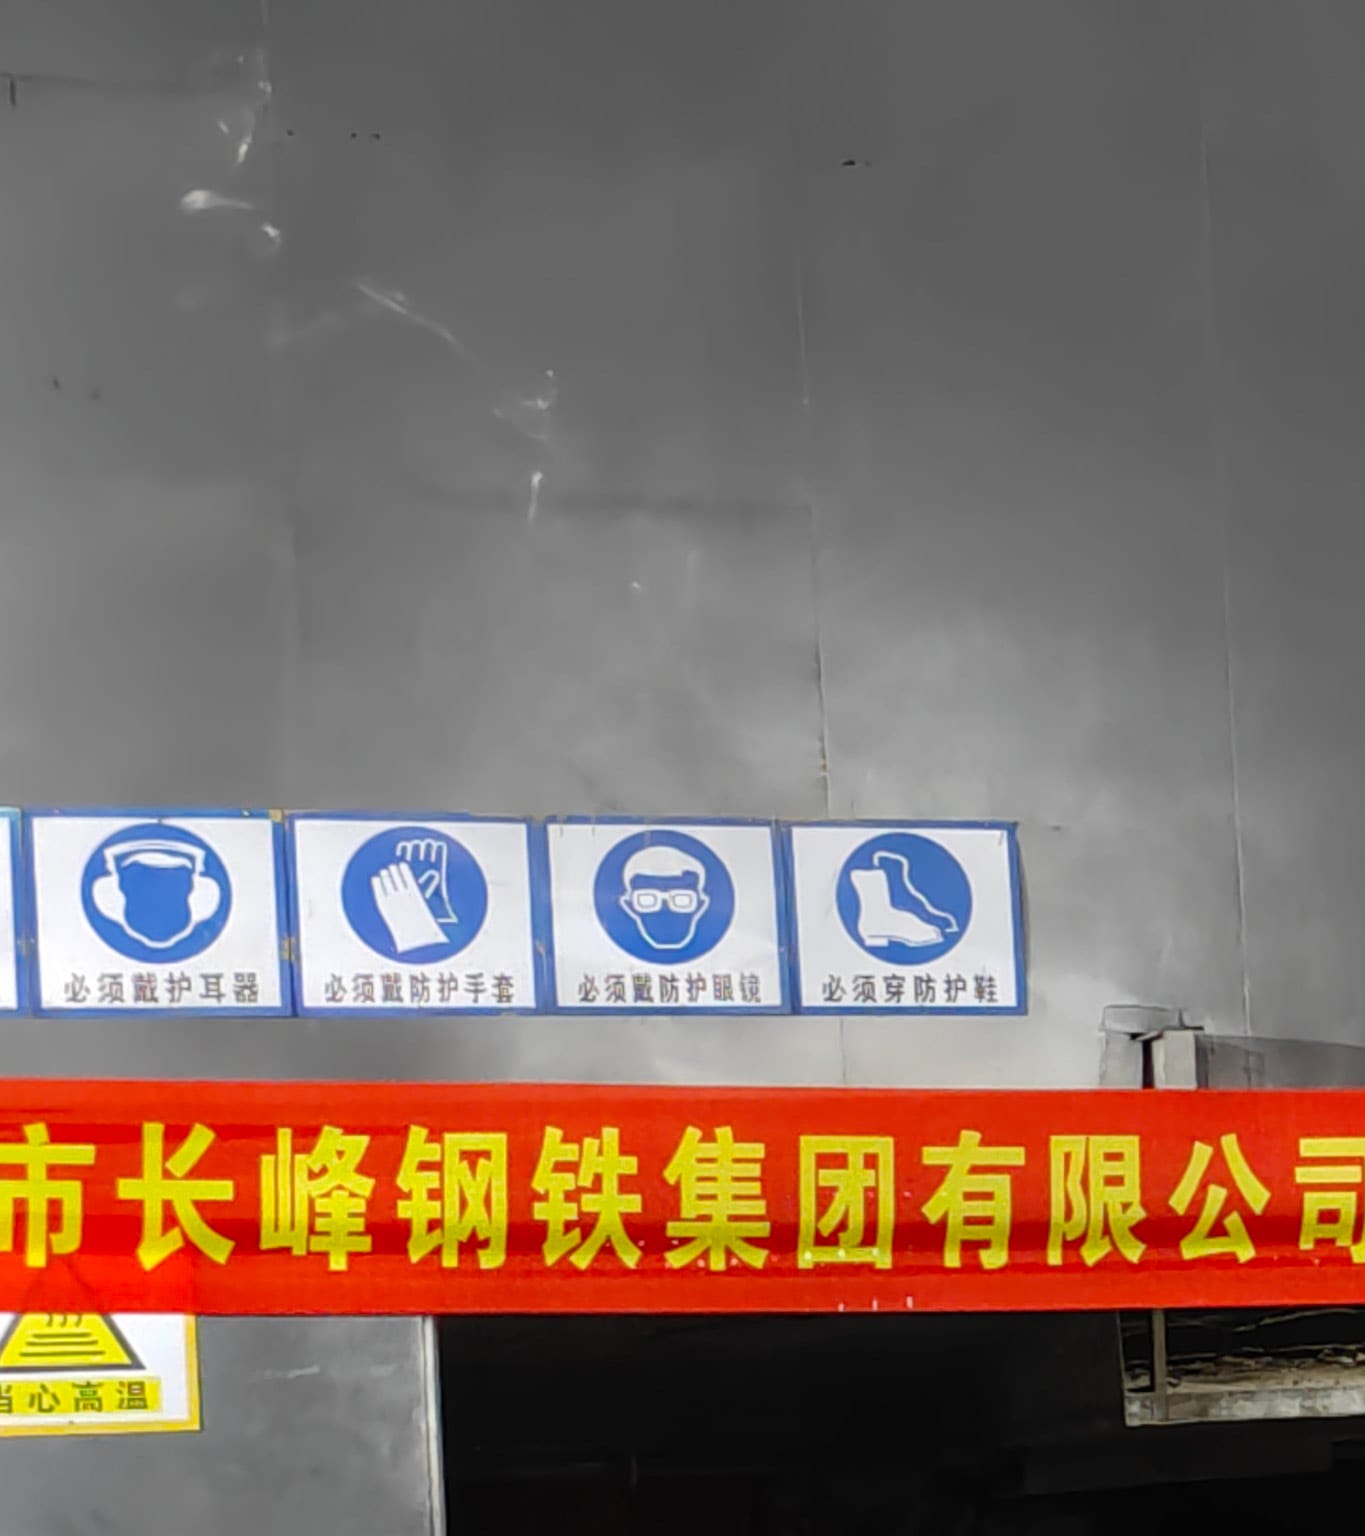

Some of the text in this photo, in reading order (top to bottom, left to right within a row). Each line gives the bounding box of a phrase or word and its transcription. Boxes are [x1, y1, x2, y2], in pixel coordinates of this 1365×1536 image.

[64, 972, 260, 1004] 必须戴护耳器
[324, 973, 516, 1004] 必须戴防护手套
[577, 973, 762, 1004] 必须戴防护眼镜
[821, 975, 1000, 1004] 必须穿防护鞋
